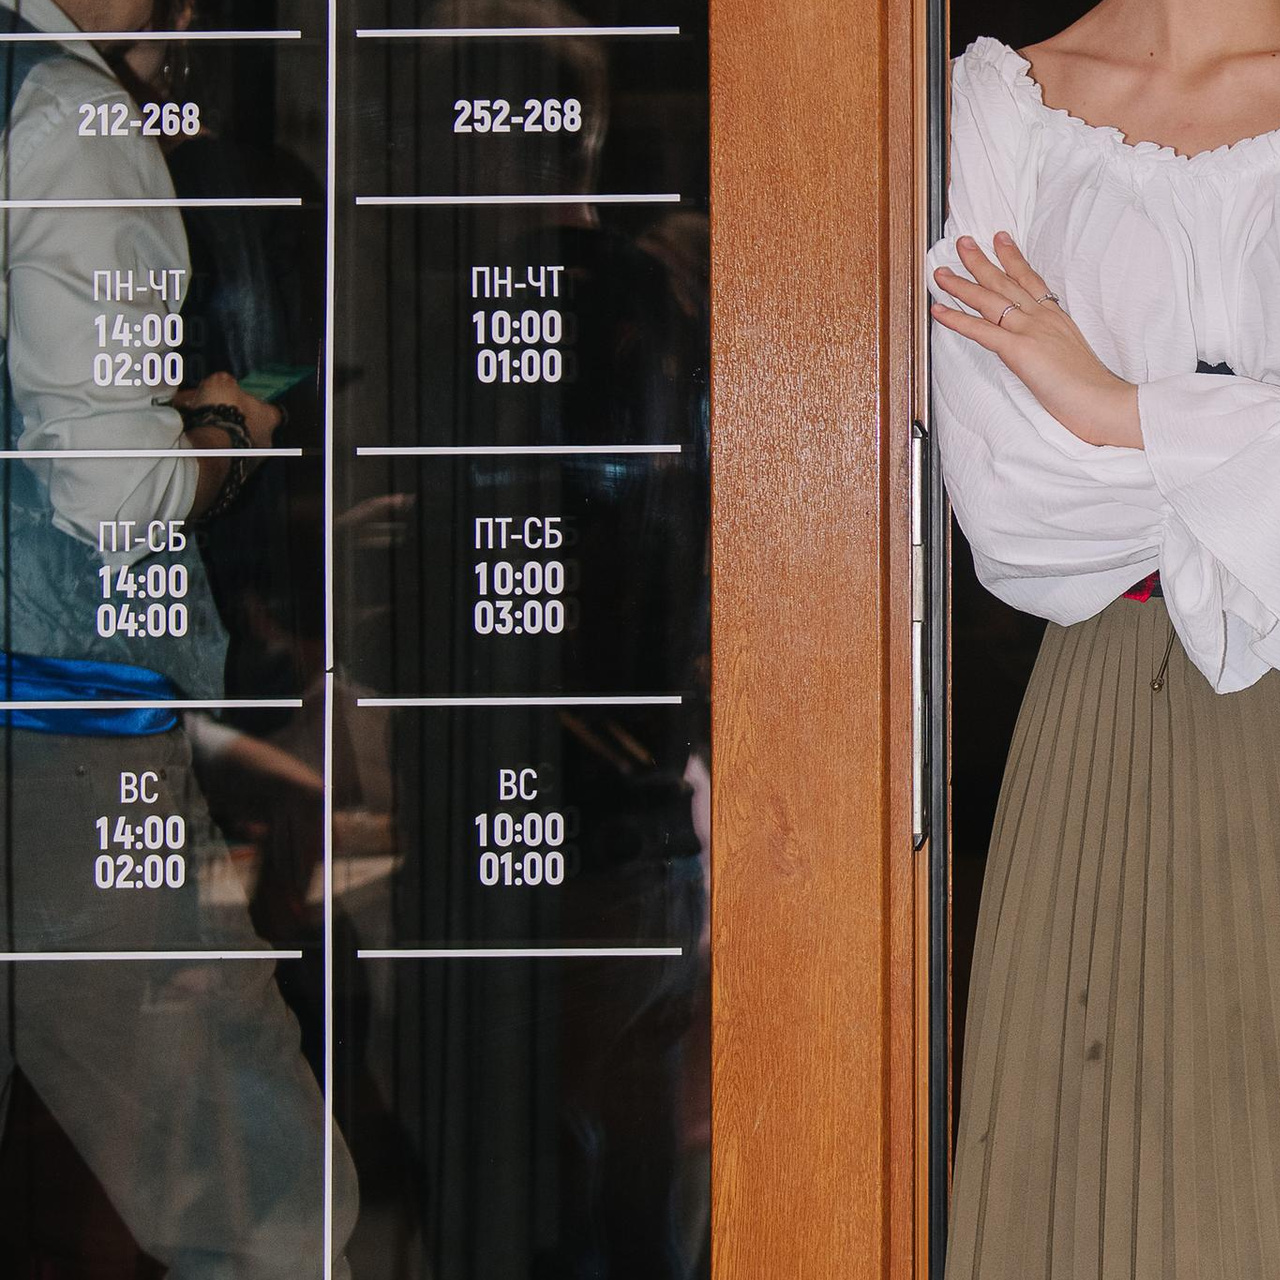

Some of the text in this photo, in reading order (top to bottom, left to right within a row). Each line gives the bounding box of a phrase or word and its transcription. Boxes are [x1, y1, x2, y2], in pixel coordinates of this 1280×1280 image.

[78, 102, 200, 137] 212-268
[453, 98, 582, 133] 252-268
[93, 269, 186, 302] ПН-ЧТ
[472, 265, 565, 298] ПН-ЧТ
[94, 313, 184, 348] 14:00
[472, 309, 562, 345] 10:00
[93, 352, 184, 387] 02:00
[477, 348, 562, 383] 01:00
[98, 520, 187, 553] ПТ-СБ
[474, 516, 563, 550] ПТ-СБ
[98, 564, 188, 599] 14:00
[475, 560, 564, 596] 10:00
[97, 603, 188, 638] 04:00
[474, 599, 564, 635] 03:00
[120, 771, 159, 804] ВС
[499, 768, 538, 801] ВС
[96, 815, 185, 850] 14:00
[475, 812, 564, 847] 10:00
[95, 854, 185, 889] 02:00
[479, 851, 564, 886] 01:00
